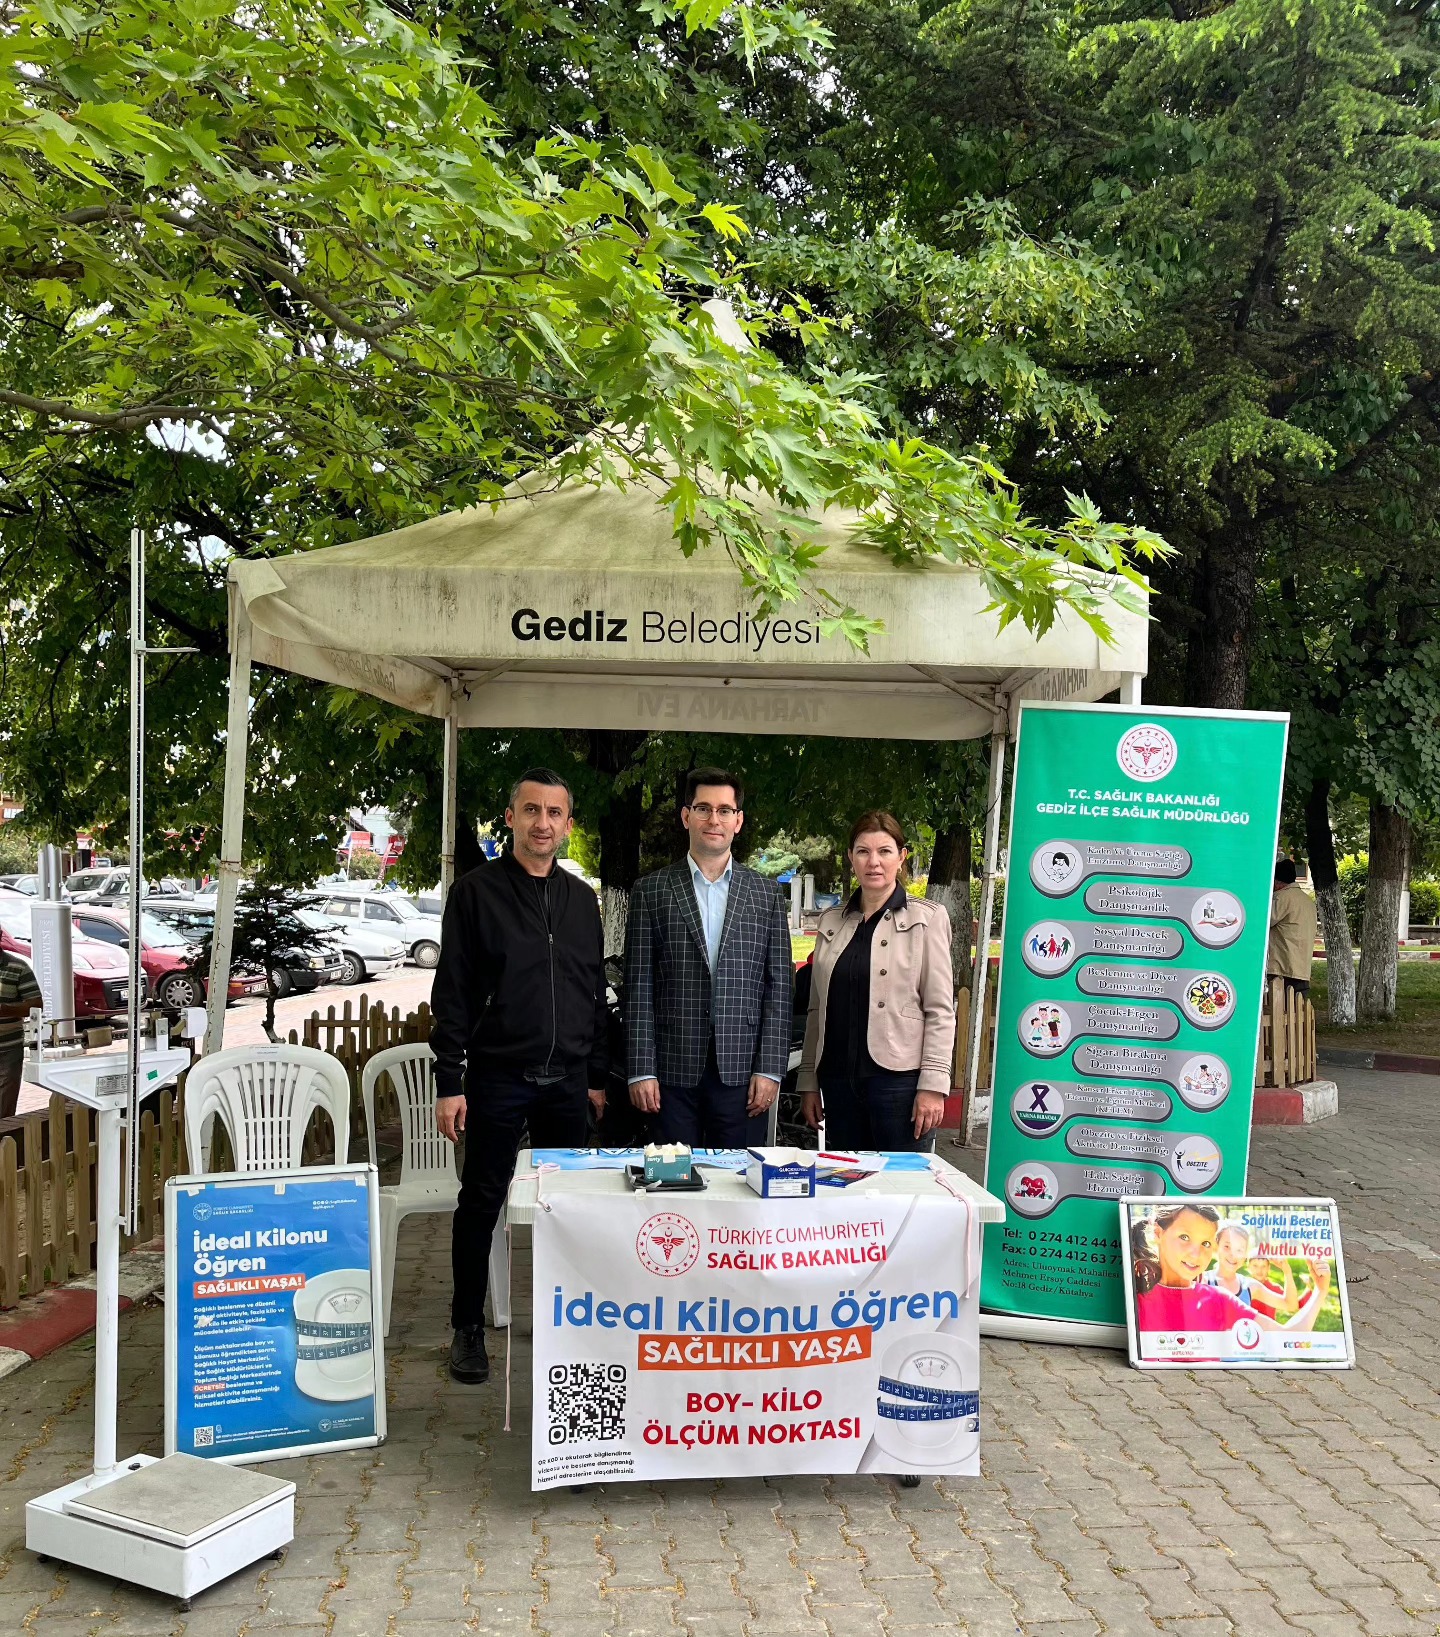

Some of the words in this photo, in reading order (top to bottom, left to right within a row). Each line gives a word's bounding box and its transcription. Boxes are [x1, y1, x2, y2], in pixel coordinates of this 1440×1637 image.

[511, 607, 628, 643] Gediz
[641, 607, 823, 653] Belediyesi
[1068, 789, 1091, 800] T.C.
[1094, 788, 1143, 803] SAĞLIK
[1145, 792, 1221, 807] BAKANLIĞI
[1036, 802, 1076, 816] GEDİZ
[1080, 804, 1109, 818] İLÇE
[1112, 804, 1161, 819] SAĞLIK
[1163, 808, 1250, 825] MÜDÜRLÜĞÜ
[1108, 885, 1162, 900] Psikolojik
[1099, 898, 1169, 913] Danışmanlık
[1094, 925, 1128, 940] Sosyal
[1130, 927, 1169, 940] Destek
[1093, 938, 1166, 954] Danışmanlığı
[1086, 966, 1134, 980] Beslenme
[1136, 972, 1148, 980] ve
[1150, 969, 1178, 983] Diyet
[1097, 979, 1165, 995] Danışmanlığı
[1088, 1004, 1159, 1021] Çocuk-Ergen
[1086, 1017, 1159, 1035] Danışmanlığı
[1085, 1045, 1119, 1062] Sigara
[1121, 1047, 1168, 1062] Bırakma
[1089, 1059, 1162, 1076] Danışmanlığı
[1080, 1128, 1116, 1139] Obezite
[1128, 1131, 1164, 1144] Fiziksel
[1072, 1137, 1109, 1150] Aktivite
[1109, 1141, 1170, 1157] Danışmanlığı
[1083, 1169, 1110, 1183] Halk
[1110, 1169, 1145, 1186] Sağlığı
[1086, 1182, 1140, 1196] Hizmetleri
[1241, 1213, 1287, 1229] Sağlıklı
[1290, 1214, 1330, 1228] Beslen
[194, 1230, 250, 1253] İdeal
[256, 1228, 328, 1248] Kilonu
[708, 1226, 773, 1245] TÜRKİYE
[776, 1219, 885, 1243] CUMHURİYETİ
[1003, 1227, 1022, 1239] Tel:
[1028, 1230, 1037, 1241] 0
[1040, 1232, 1063, 1243] 274
[1065, 1234, 1088, 1246] 412
[1091, 1238, 1108, 1249] 44
[1271, 1227, 1318, 1240] Hareket
[1319, 1228, 1333, 1240] Et
[707, 1249, 779, 1271] SAĞLIK
[782, 1243, 888, 1268] BAKANLIĞI
[1002, 1242, 1026, 1255] Fax:
[1029, 1246, 1037, 1256] 0
[1040, 1248, 1063, 1259] 274
[1065, 1250, 1088, 1262] 412
[1090, 1253, 1107, 1264] 63
[1257, 1242, 1297, 1257] Mutlu
[1302, 1243, 1333, 1260] Yaşa
[193, 1254, 266, 1278] Öğren
[1003, 1257, 1030, 1268] Adres:
[1032, 1261, 1076, 1275] Uluoymak
[1078, 1267, 1120, 1279] Mahallesi
[197, 1281, 260, 1296] SAĞLIKLI
[263, 1275, 303, 1292] YAŞA!
[1002, 1268, 1037, 1280] Mehmet
[1040, 1273, 1065, 1285] Ersoy
[1066, 1276, 1102, 1288] Caddesi
[1002, 1279, 1026, 1289] No:18
[553, 1285, 664, 1328] İdeal
[678, 1297, 818, 1333] Kilonu
[831, 1288, 959, 1331] Öğren
[644, 1334, 780, 1366] SAĞLIKLI
[793, 1332, 863, 1364] YAŞA
[686, 1392, 753, 1414] BOY-
[761, 1386, 823, 1412] KİLO
[643, 1423, 743, 1451] ÖLÇÜM
[747, 1417, 861, 1445] NOKTASI
[565, 1453, 592, 1461] okutarak
